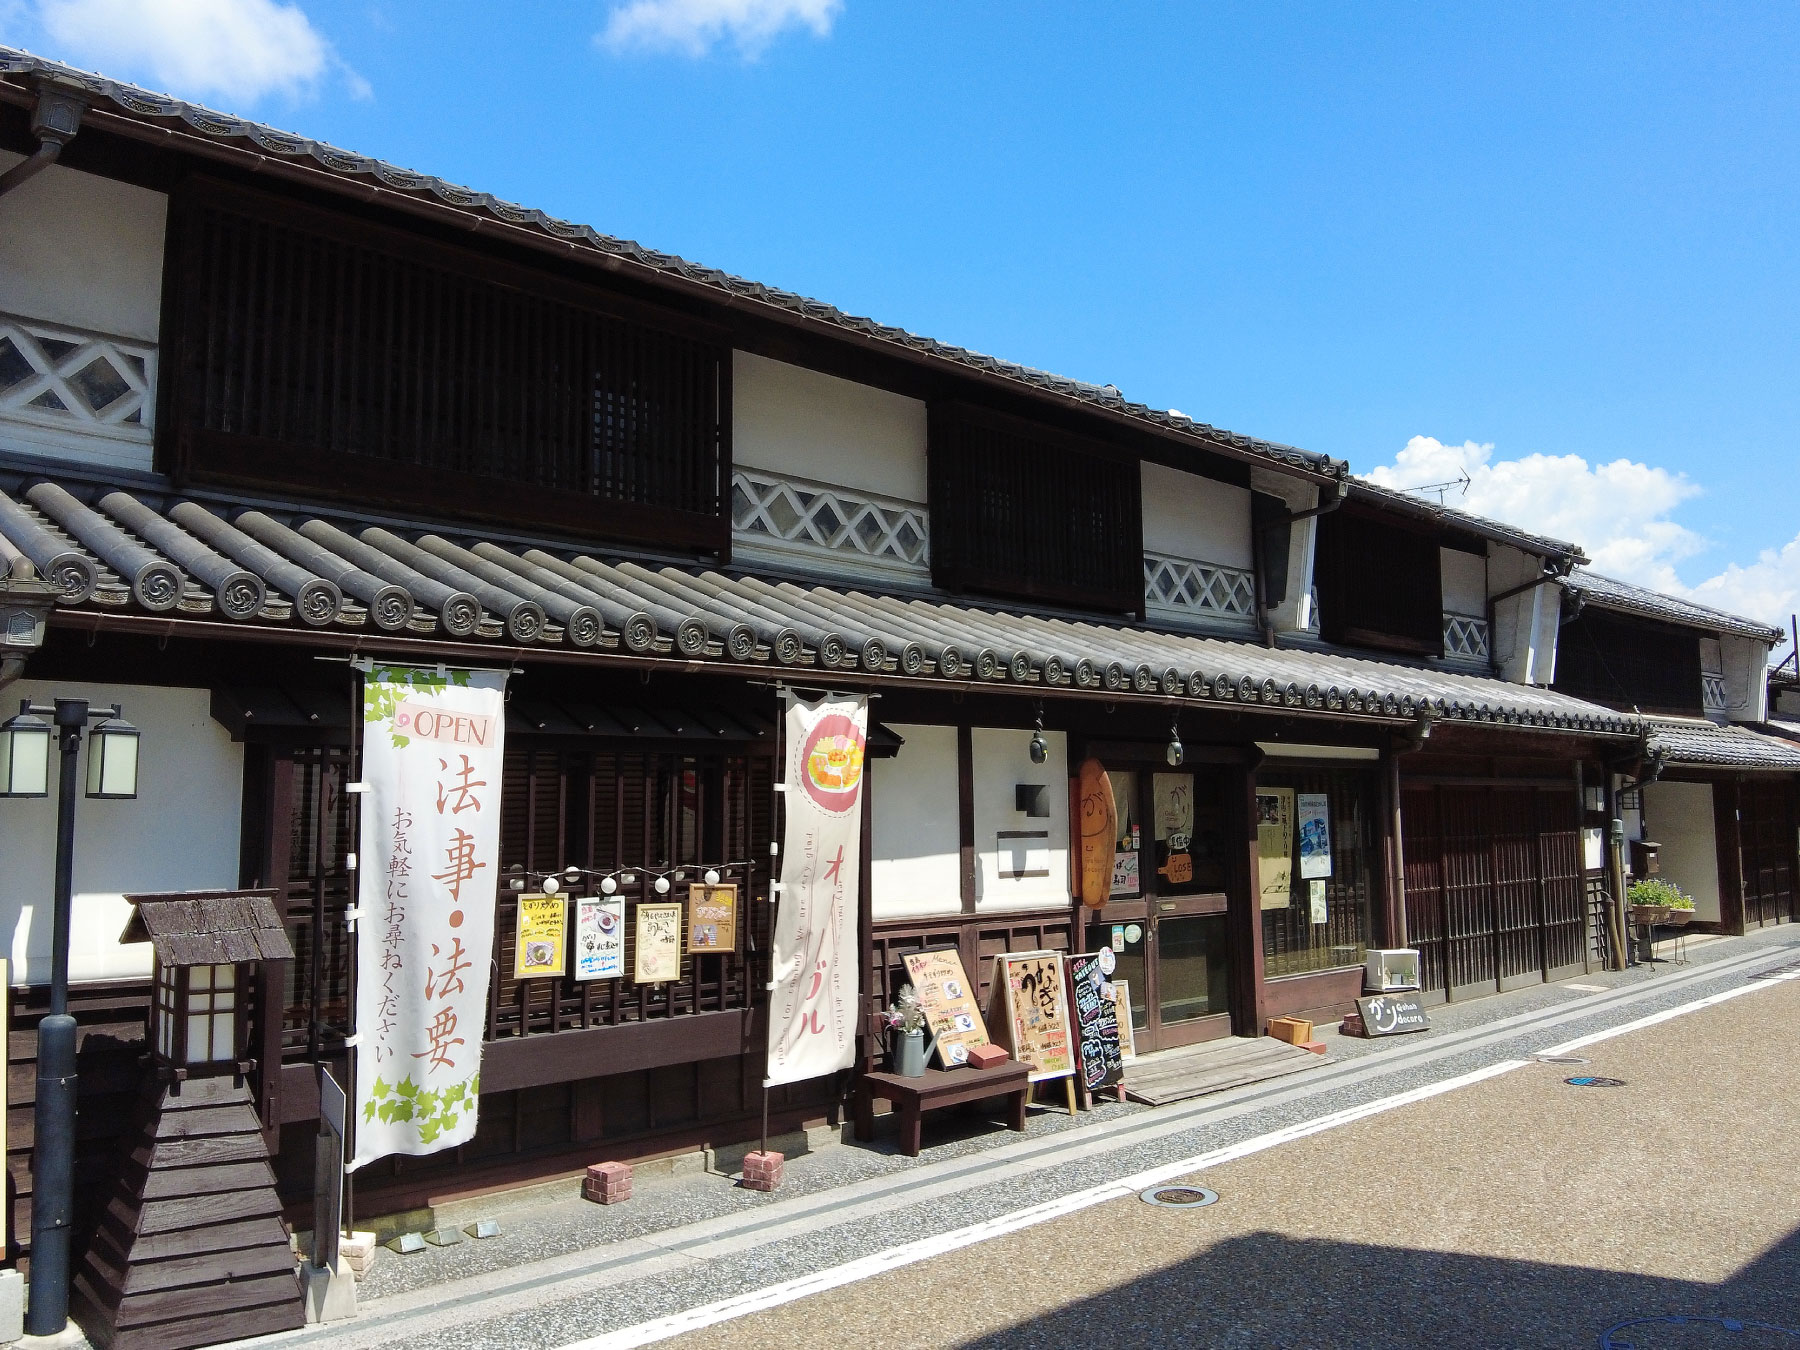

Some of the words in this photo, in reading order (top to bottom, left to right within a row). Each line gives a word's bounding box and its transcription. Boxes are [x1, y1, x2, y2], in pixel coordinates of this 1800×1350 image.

[413, 711, 488, 745] OPEN
[804, 832, 814, 859] glad
[375, 806, 413, 1063] お気軽にお尋ねください
[931, 954, 960, 967] Menu
[1074, 957, 1099, 981] TAKEOUT
